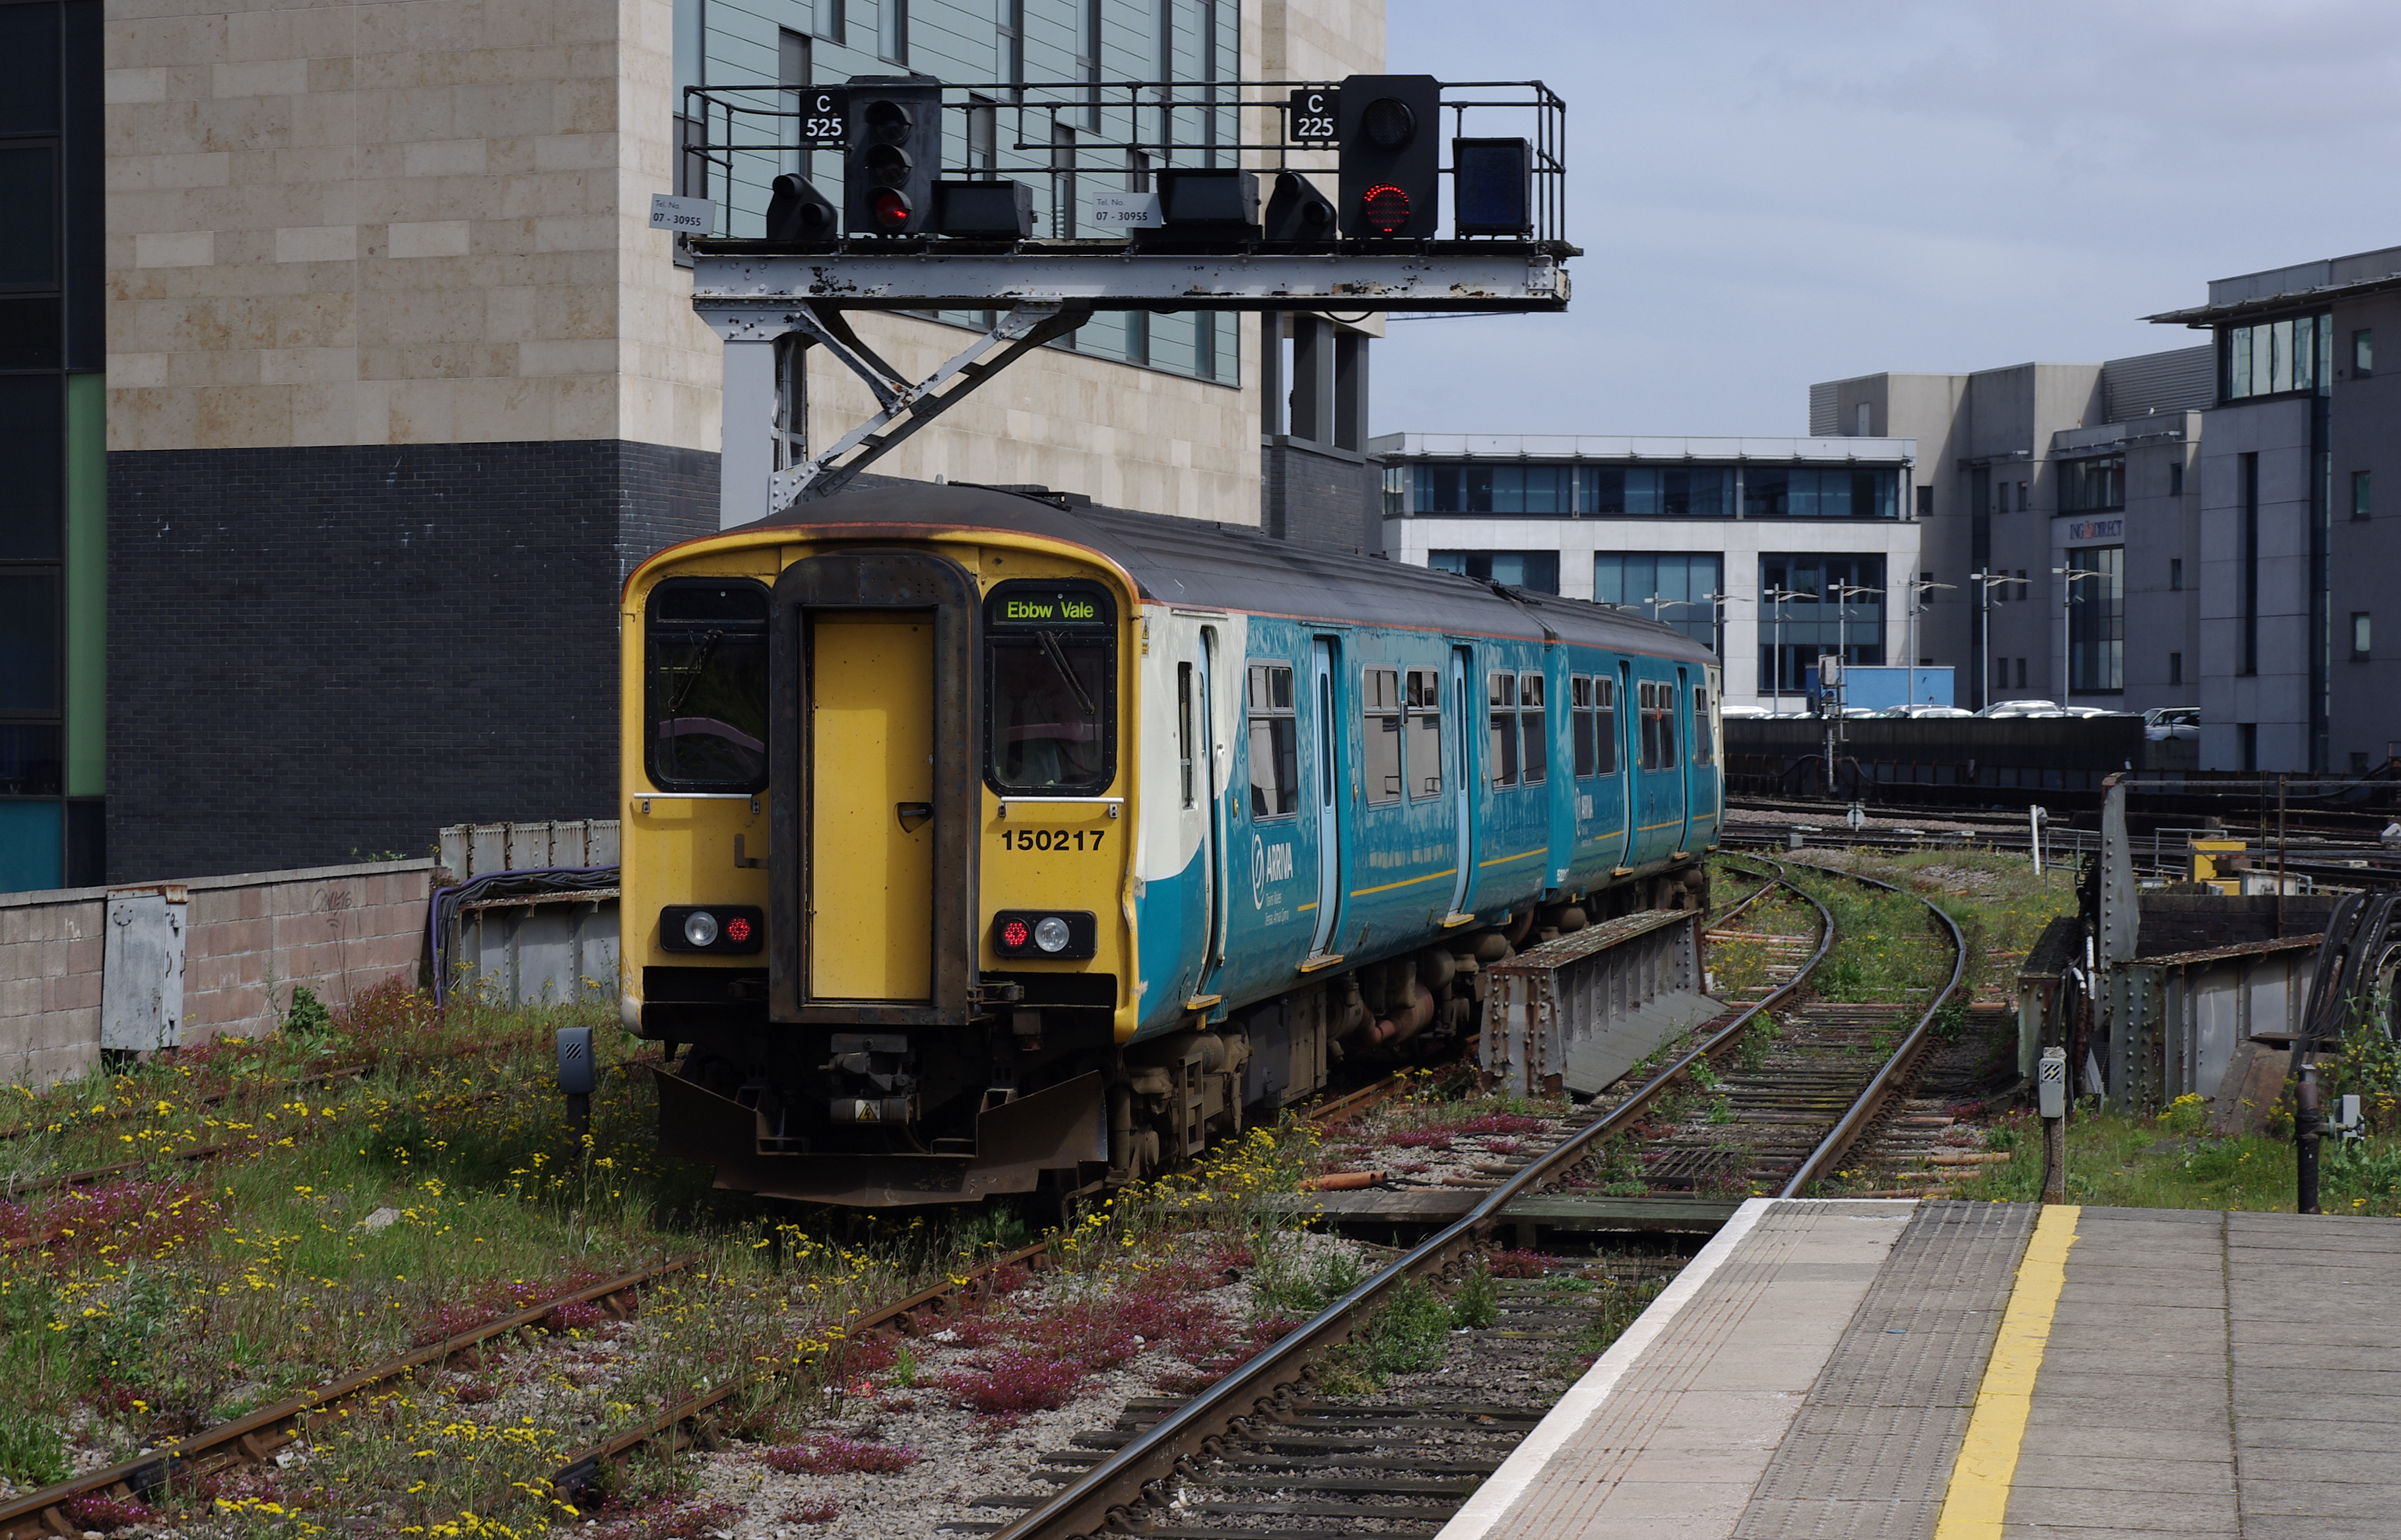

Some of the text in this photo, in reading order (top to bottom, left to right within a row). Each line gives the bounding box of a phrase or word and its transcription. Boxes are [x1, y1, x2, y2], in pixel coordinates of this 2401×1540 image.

[816, 95, 831, 113] C
[1307, 94, 1324, 113] C
[805, 118, 843, 137] 525
[1298, 117, 1334, 137] 225
[653, 212, 665, 222] 07
[673, 214, 701, 226] 30955
[1096, 212, 1108, 220] 07
[1117, 212, 1148, 221] 30955
[2070, 520, 2122, 540] ING DIRECT
[1008, 601, 1094, 618] Ebbw Vale
[1002, 830, 1105, 850] 150217
[1266, 842, 1294, 883] ARRIVA
